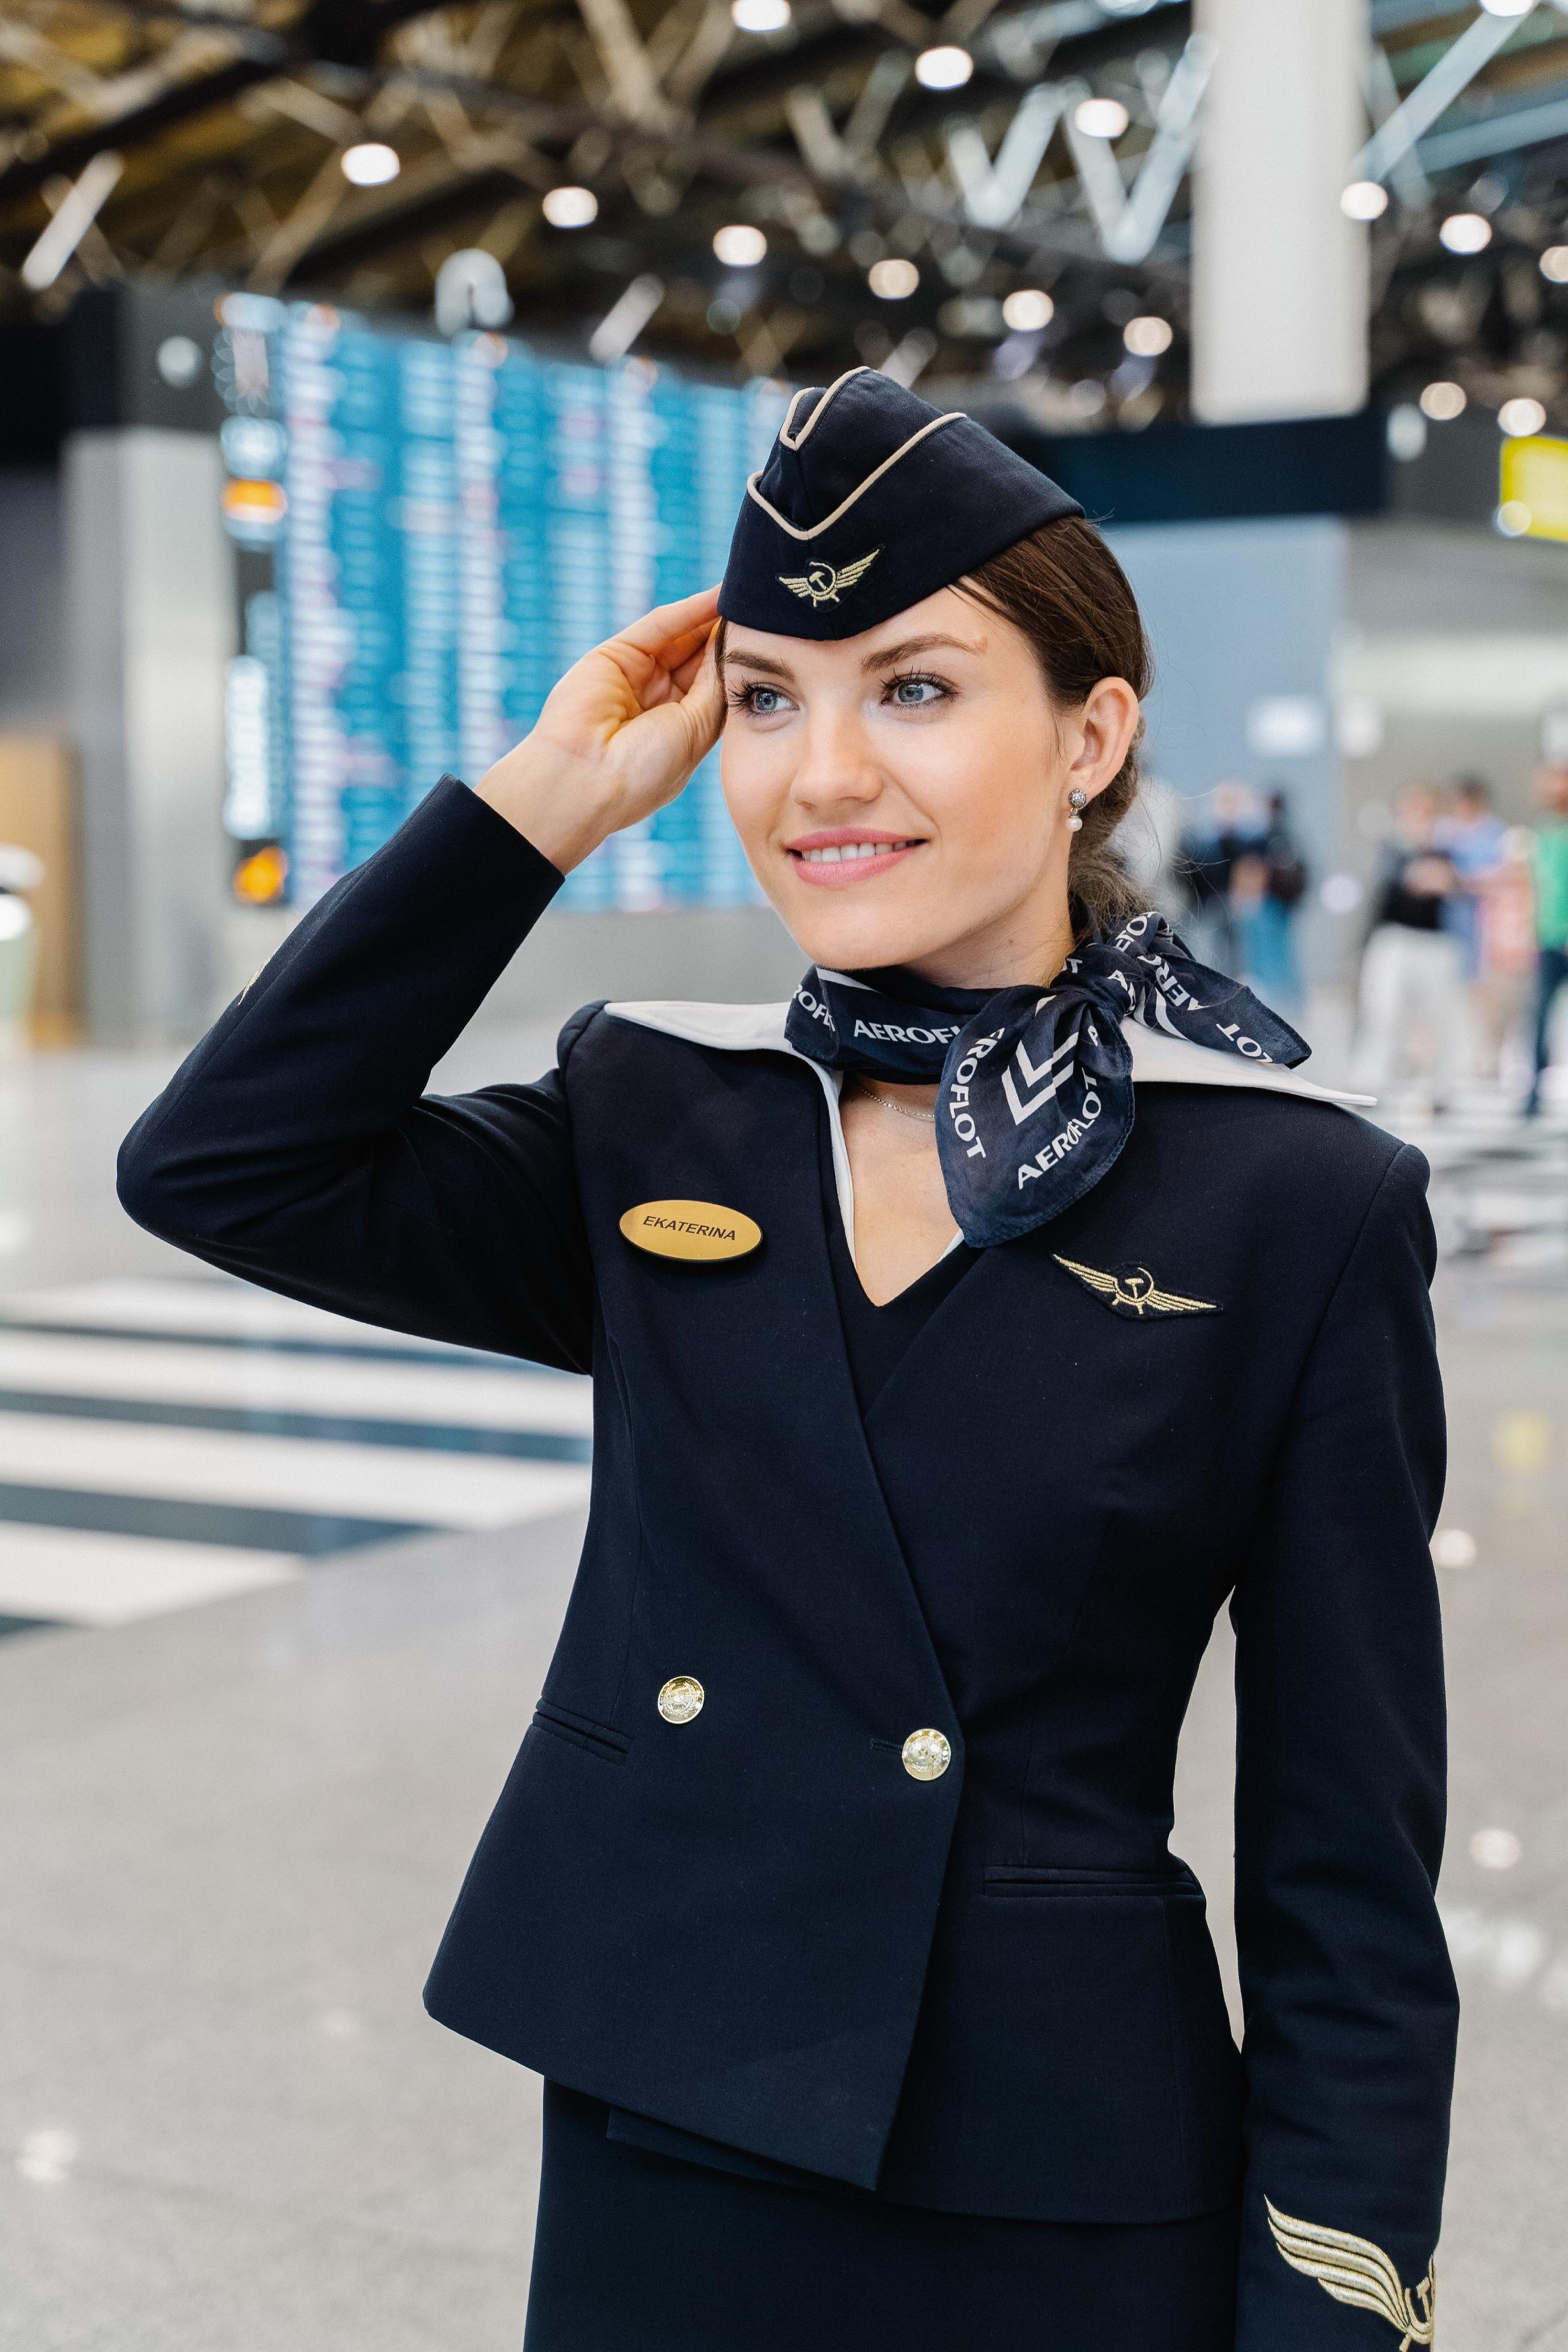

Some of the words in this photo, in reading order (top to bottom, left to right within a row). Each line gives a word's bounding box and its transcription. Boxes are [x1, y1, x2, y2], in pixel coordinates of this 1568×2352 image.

[854, 1019, 960, 1044] AEROF
[1018, 1067, 1101, 1190] AEROFLOT
[643, 1215, 736, 1240] EKATERINA
